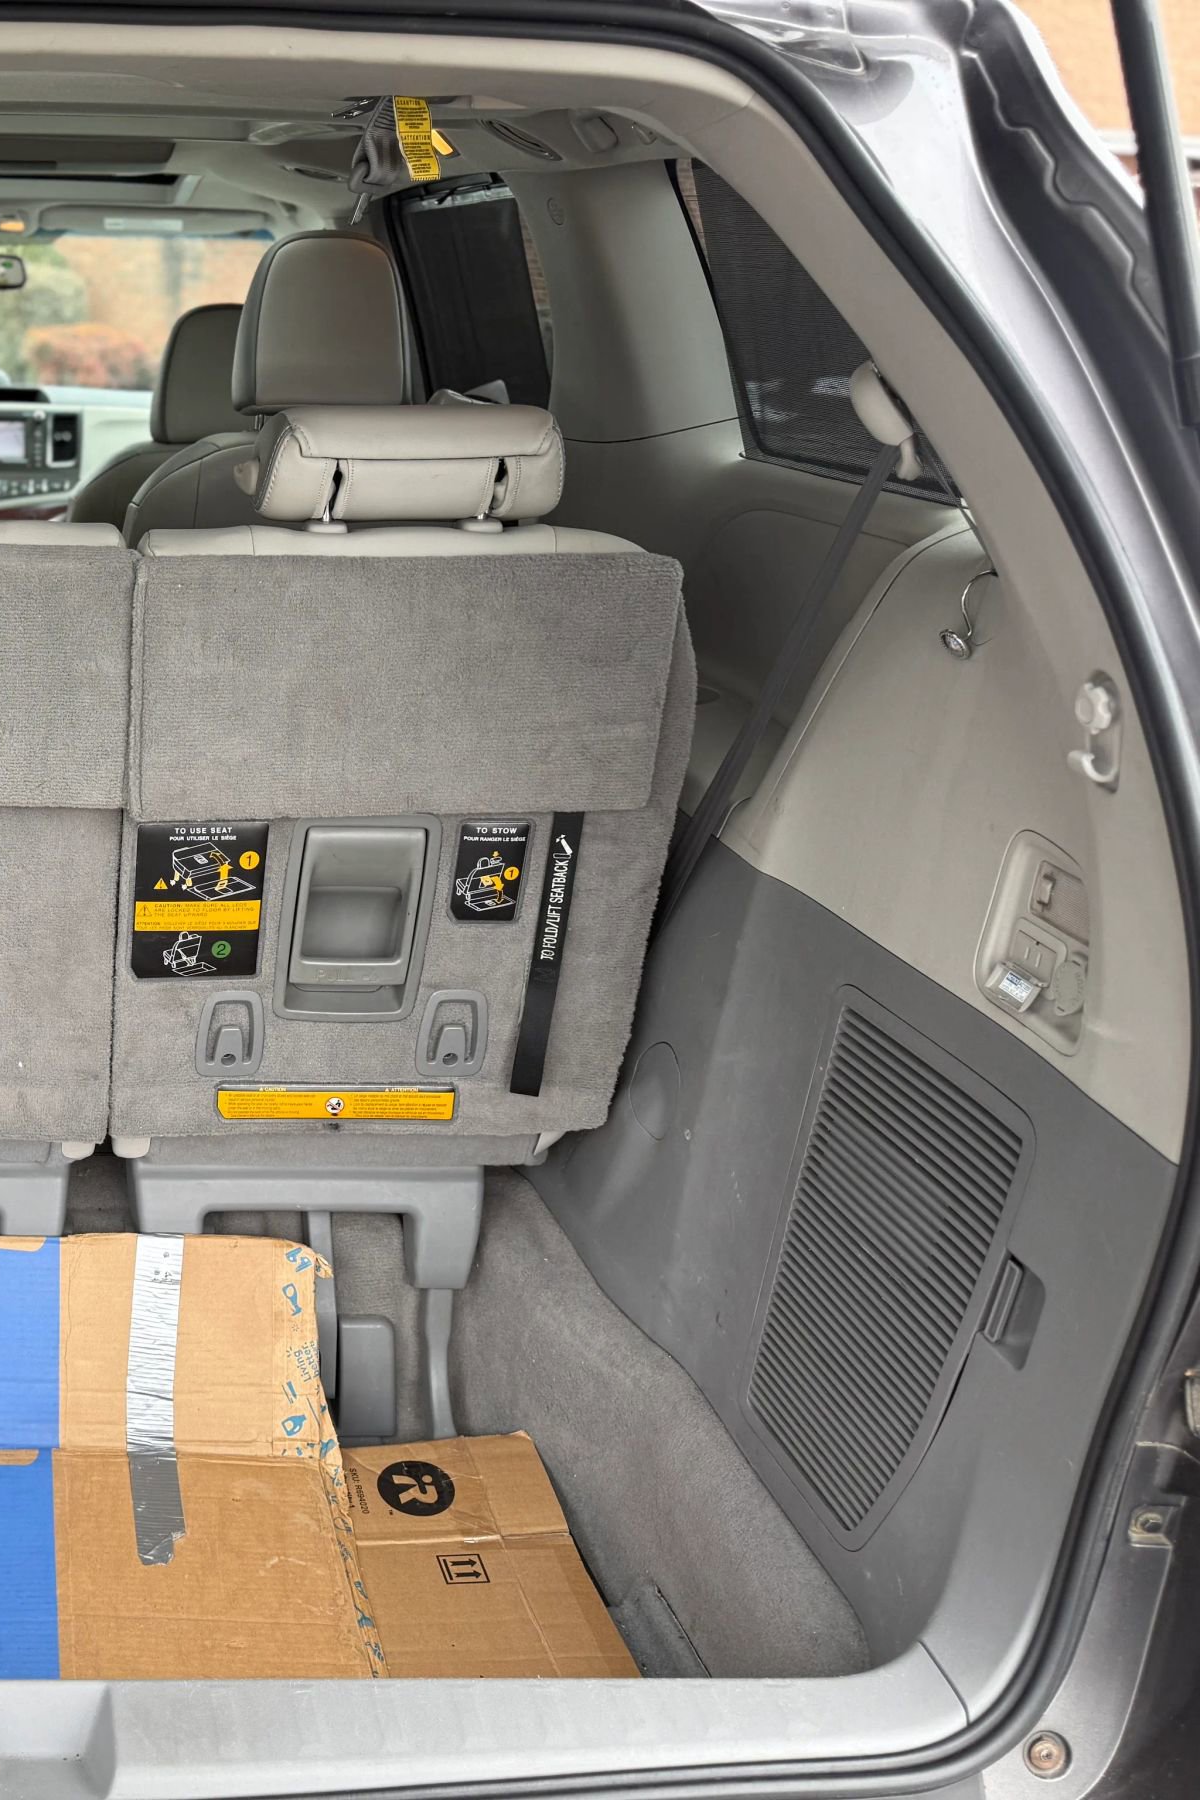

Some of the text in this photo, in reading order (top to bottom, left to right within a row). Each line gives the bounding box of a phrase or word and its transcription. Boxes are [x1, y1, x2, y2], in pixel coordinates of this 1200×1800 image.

[246, 855, 252, 866] 1
[540, 860, 570, 960] TO FOLD/LIFT SEATBACK
[217, 944, 226, 955] 2
[294, 1349, 312, 1382] Living
[349, 1468, 360, 1484] SKU:
